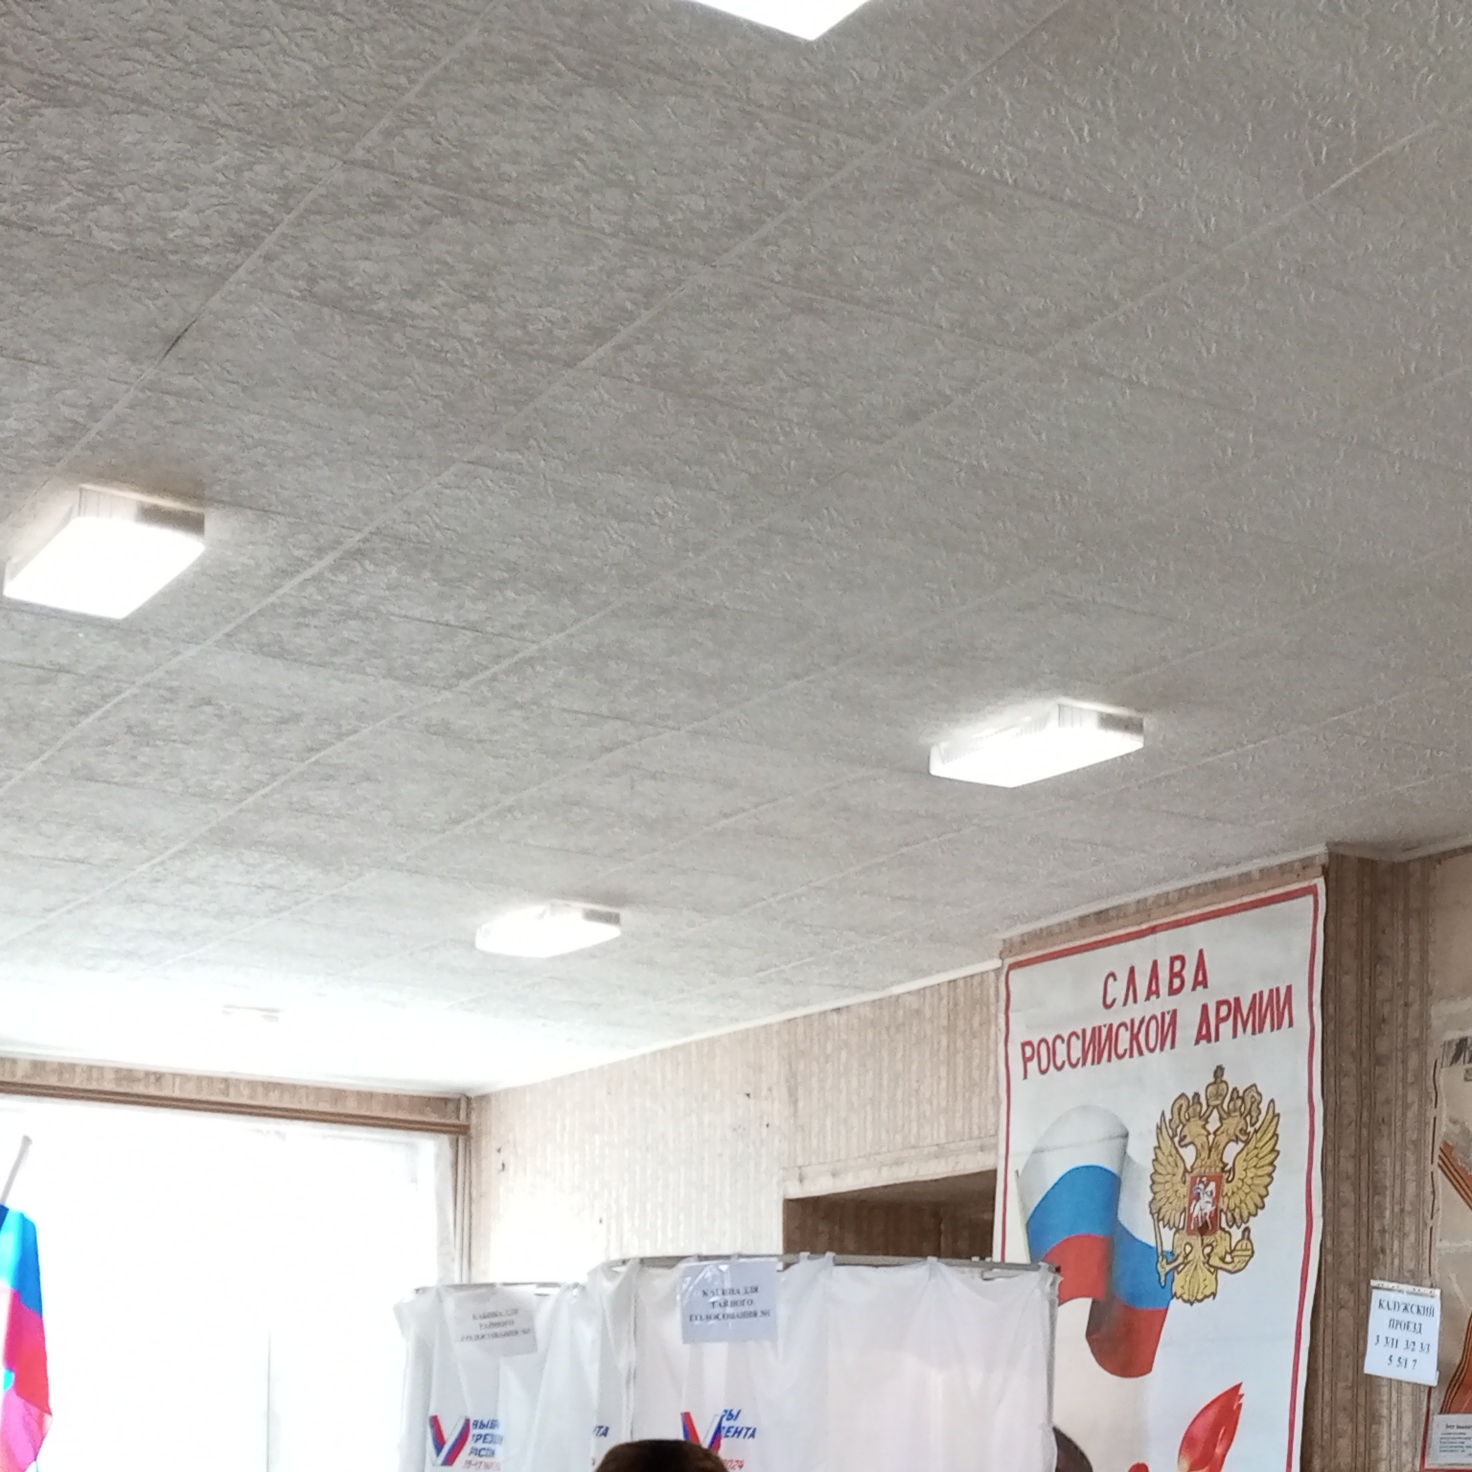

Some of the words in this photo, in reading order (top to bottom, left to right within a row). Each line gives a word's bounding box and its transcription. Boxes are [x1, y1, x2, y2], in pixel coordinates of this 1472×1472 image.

[1102, 948, 1208, 1009] СЛАВА
[1021, 1008, 1177, 1080] РОССИЙСКОЙ
[1194, 984, 1294, 1046] АРМИИ
[1378, 1299, 1435, 1317] КАЛУЖСКИЙ
[1388, 1318, 1422, 1335] ПРОЕЗД
